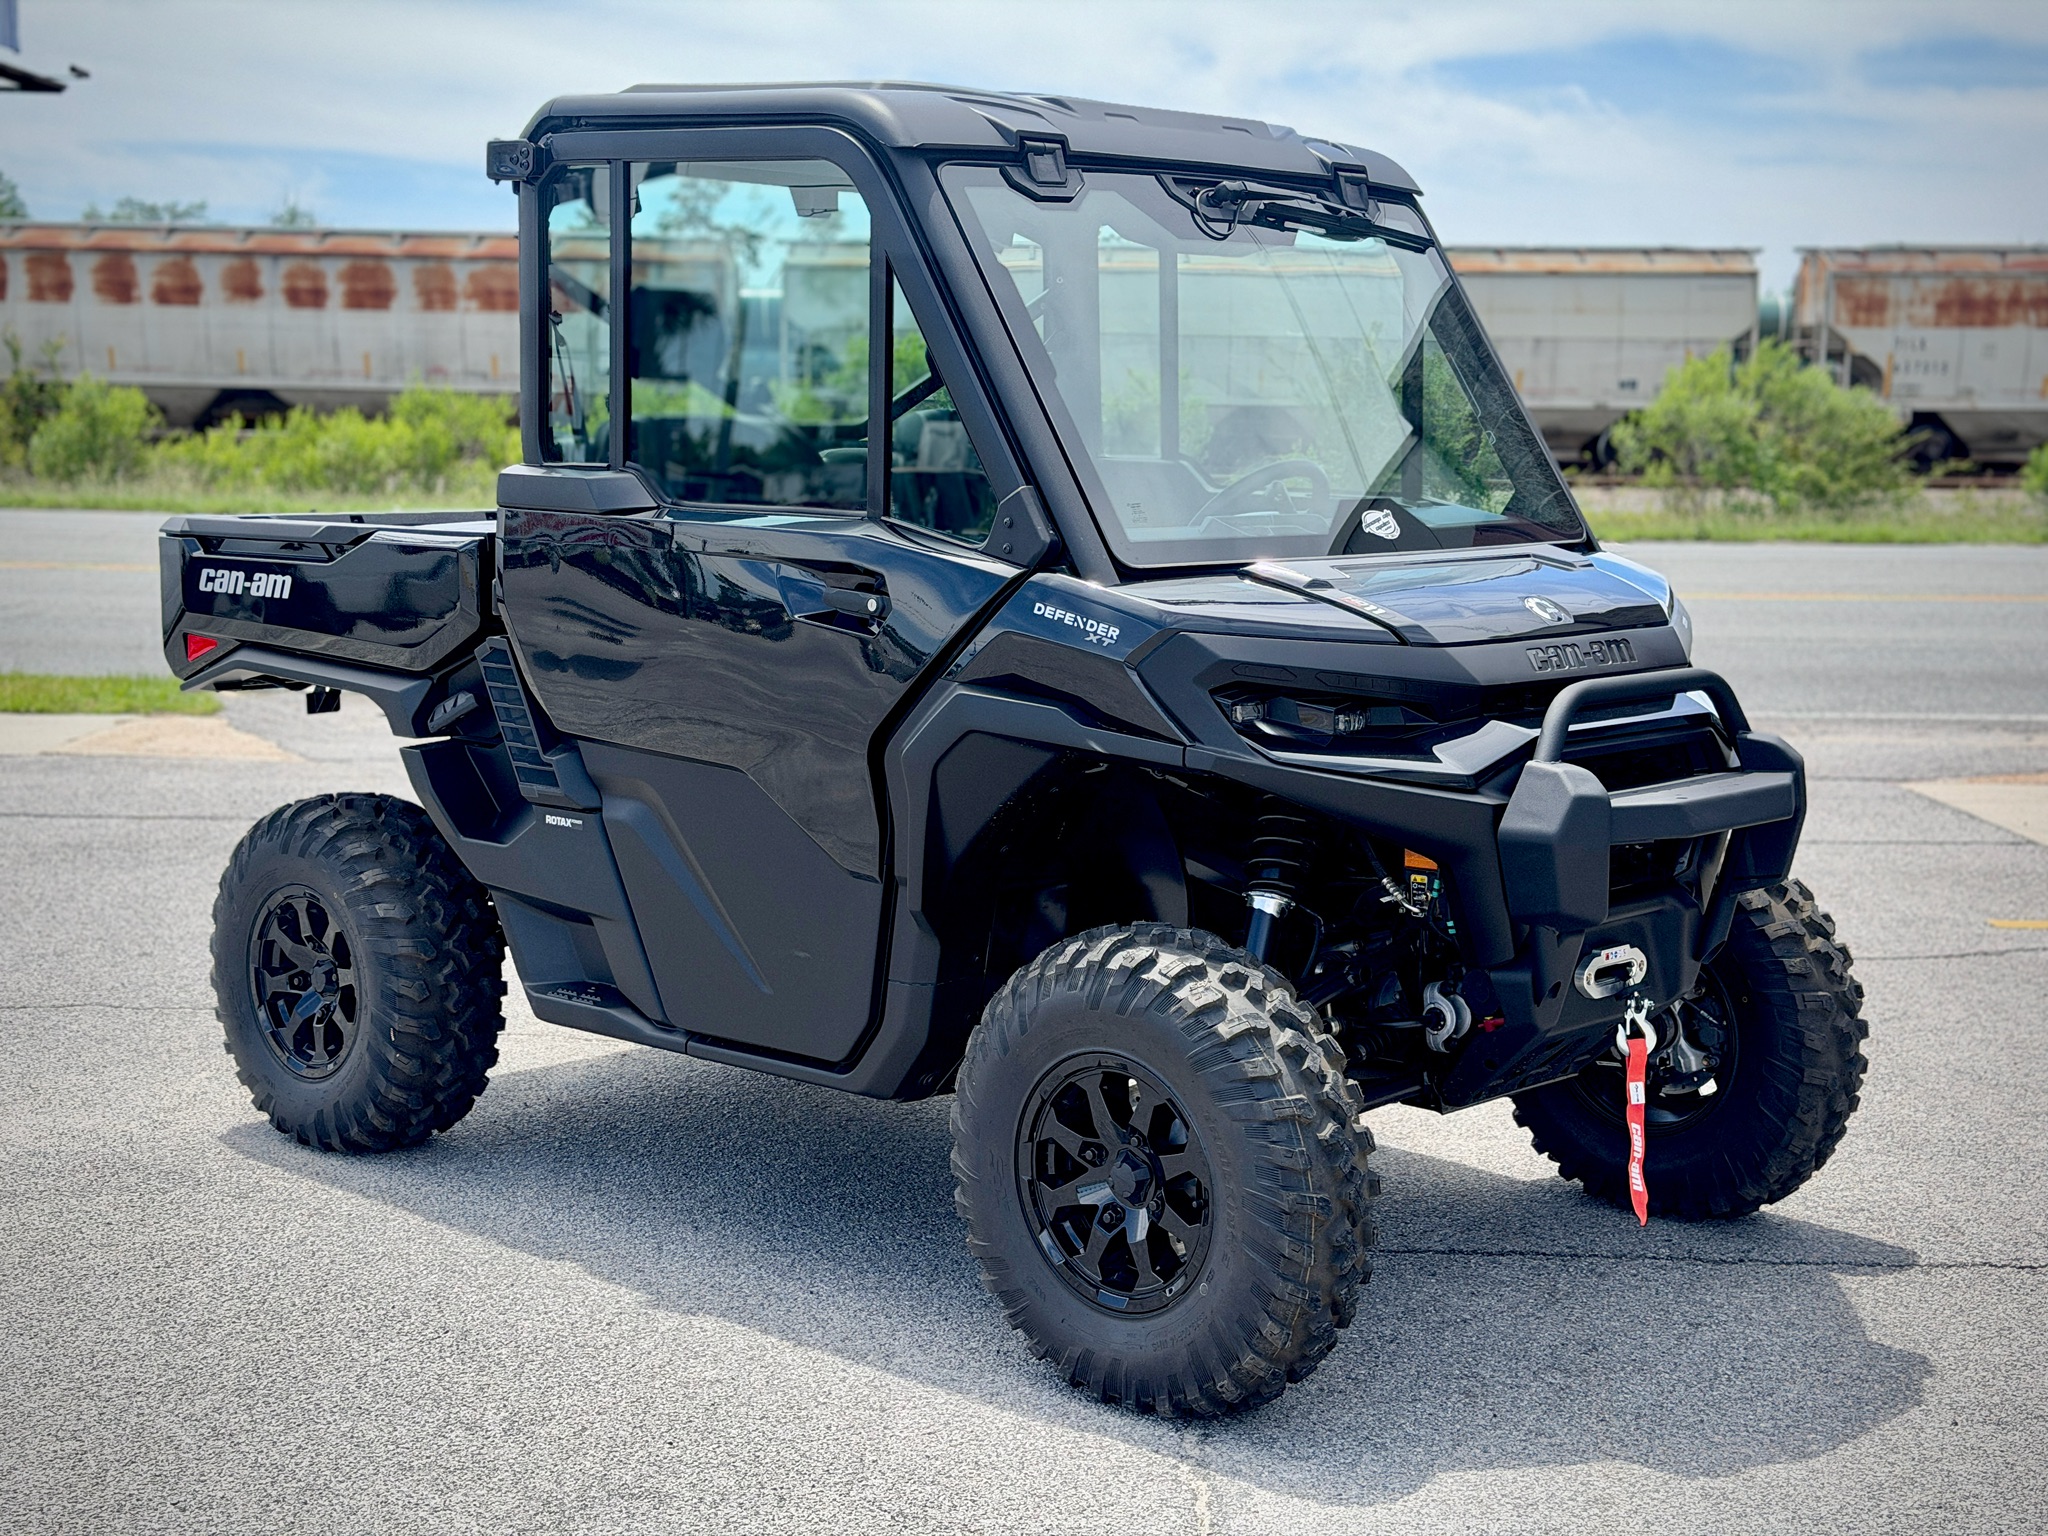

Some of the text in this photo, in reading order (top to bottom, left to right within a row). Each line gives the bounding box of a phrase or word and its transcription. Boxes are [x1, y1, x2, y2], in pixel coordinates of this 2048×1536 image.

[199, 568, 292, 599] can-am
[1033, 602, 1120, 640] DEFENDER
[1084, 633, 1116, 647] XT
[1526, 637, 1638, 673] can-am
[545, 814, 572, 828] ROTAX
[1630, 1122, 1644, 1192] can-am
